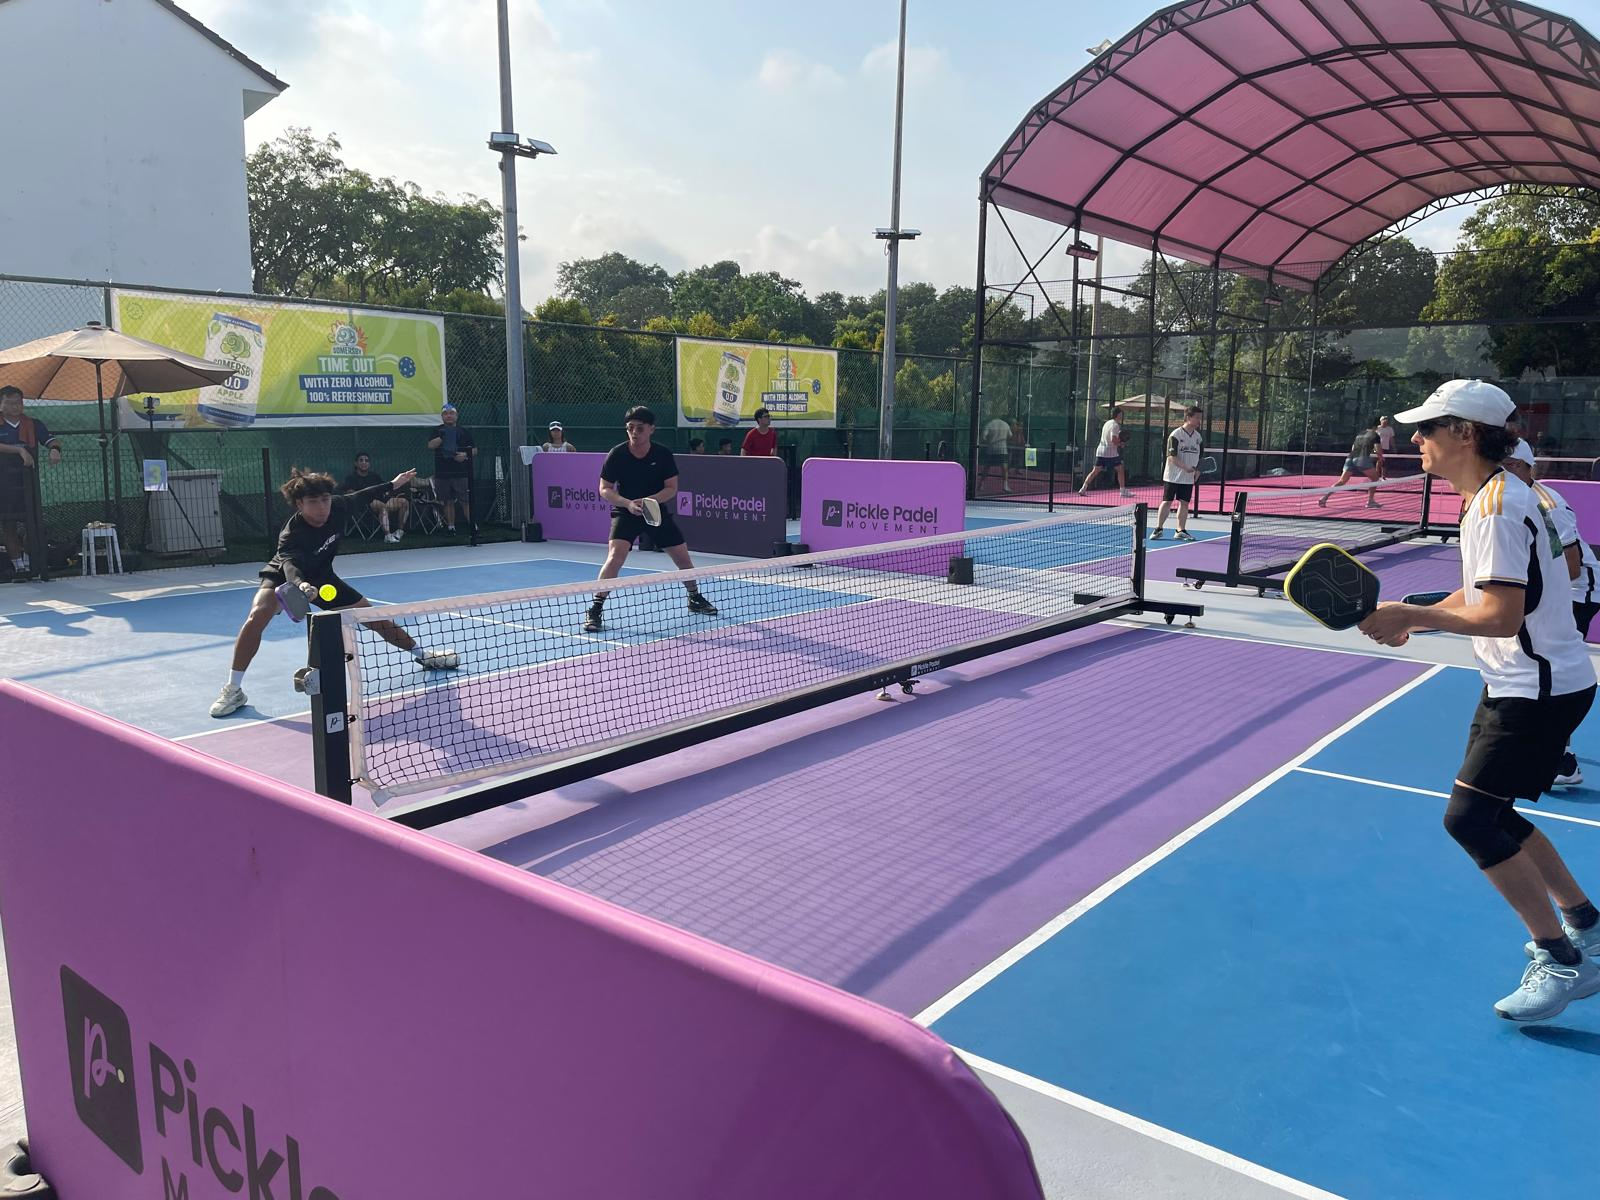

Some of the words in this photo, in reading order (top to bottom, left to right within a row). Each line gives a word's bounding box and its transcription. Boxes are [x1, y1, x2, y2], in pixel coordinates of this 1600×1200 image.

[332, 346, 362, 355] SOMERSBY
[318, 357, 350, 373] TIME
[352, 357, 375, 373] OUT
[304, 377, 329, 388] WITH
[331, 377, 352, 388] ZERO
[354, 376, 392, 388] ALCOHOL,
[217, 388, 244, 401] APPLE
[309, 391, 330, 402] 100%
[331, 391, 390, 403] REFRESHMENT
[565, 488, 595, 502] Pickle
[695, 493, 729, 510] Pickle
[731, 496, 766, 512] Padel
[695, 510, 767, 522] MOVEMENT
[846, 502, 889, 521] Pickle
[893, 506, 938, 523] Padel
[846, 520, 938, 535] MOVEMENT
[150, 1041, 341, 1200] Pickl
